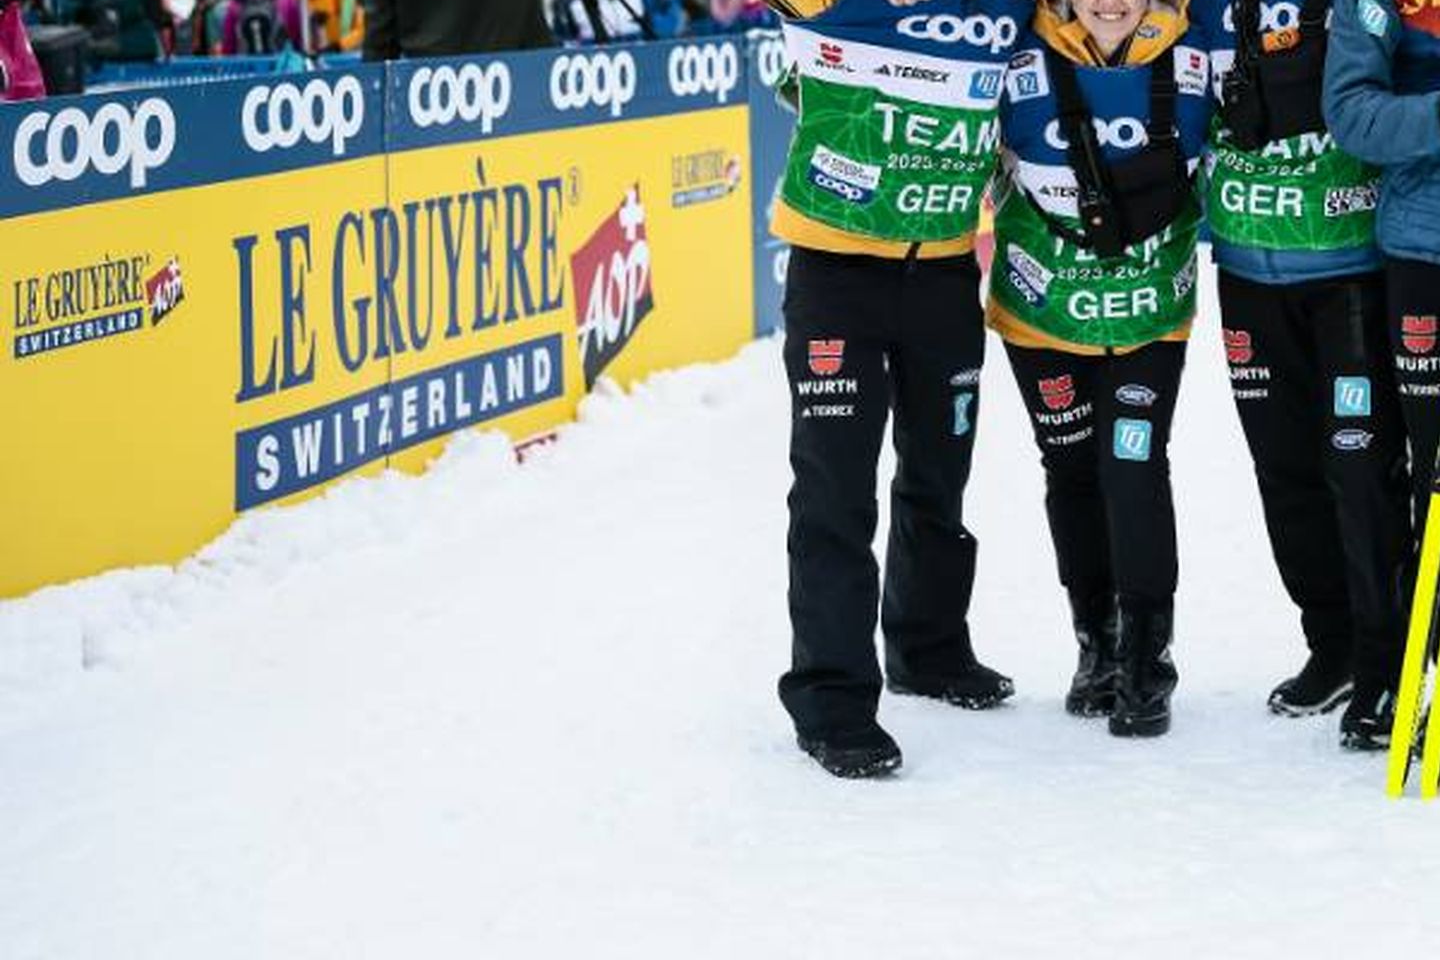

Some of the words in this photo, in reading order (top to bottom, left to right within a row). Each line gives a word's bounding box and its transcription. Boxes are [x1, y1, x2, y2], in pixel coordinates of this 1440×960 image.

[896, 13, 1018, 54] coop
[408, 60, 512, 133] coop
[549, 51, 636, 117] coop
[667, 42, 738, 103] coop
[13, 97, 177, 188] coop
[242, 75, 365, 155] coop
[873, 101, 1000, 156] TEAM
[815, 173, 864, 201] coop
[896, 183, 974, 213] GER
[1220, 179, 1304, 217] GER
[14, 277, 42, 329] LE
[45, 253, 145, 321] GRUYÈRE
[234, 224, 316, 403] LE
[331, 155, 566, 374] GRUYÈRE
[1067, 285, 1159, 321] GER
[18, 313, 139, 354] SWITZERLAND
[254, 346, 553, 492] SWITZERLAND
